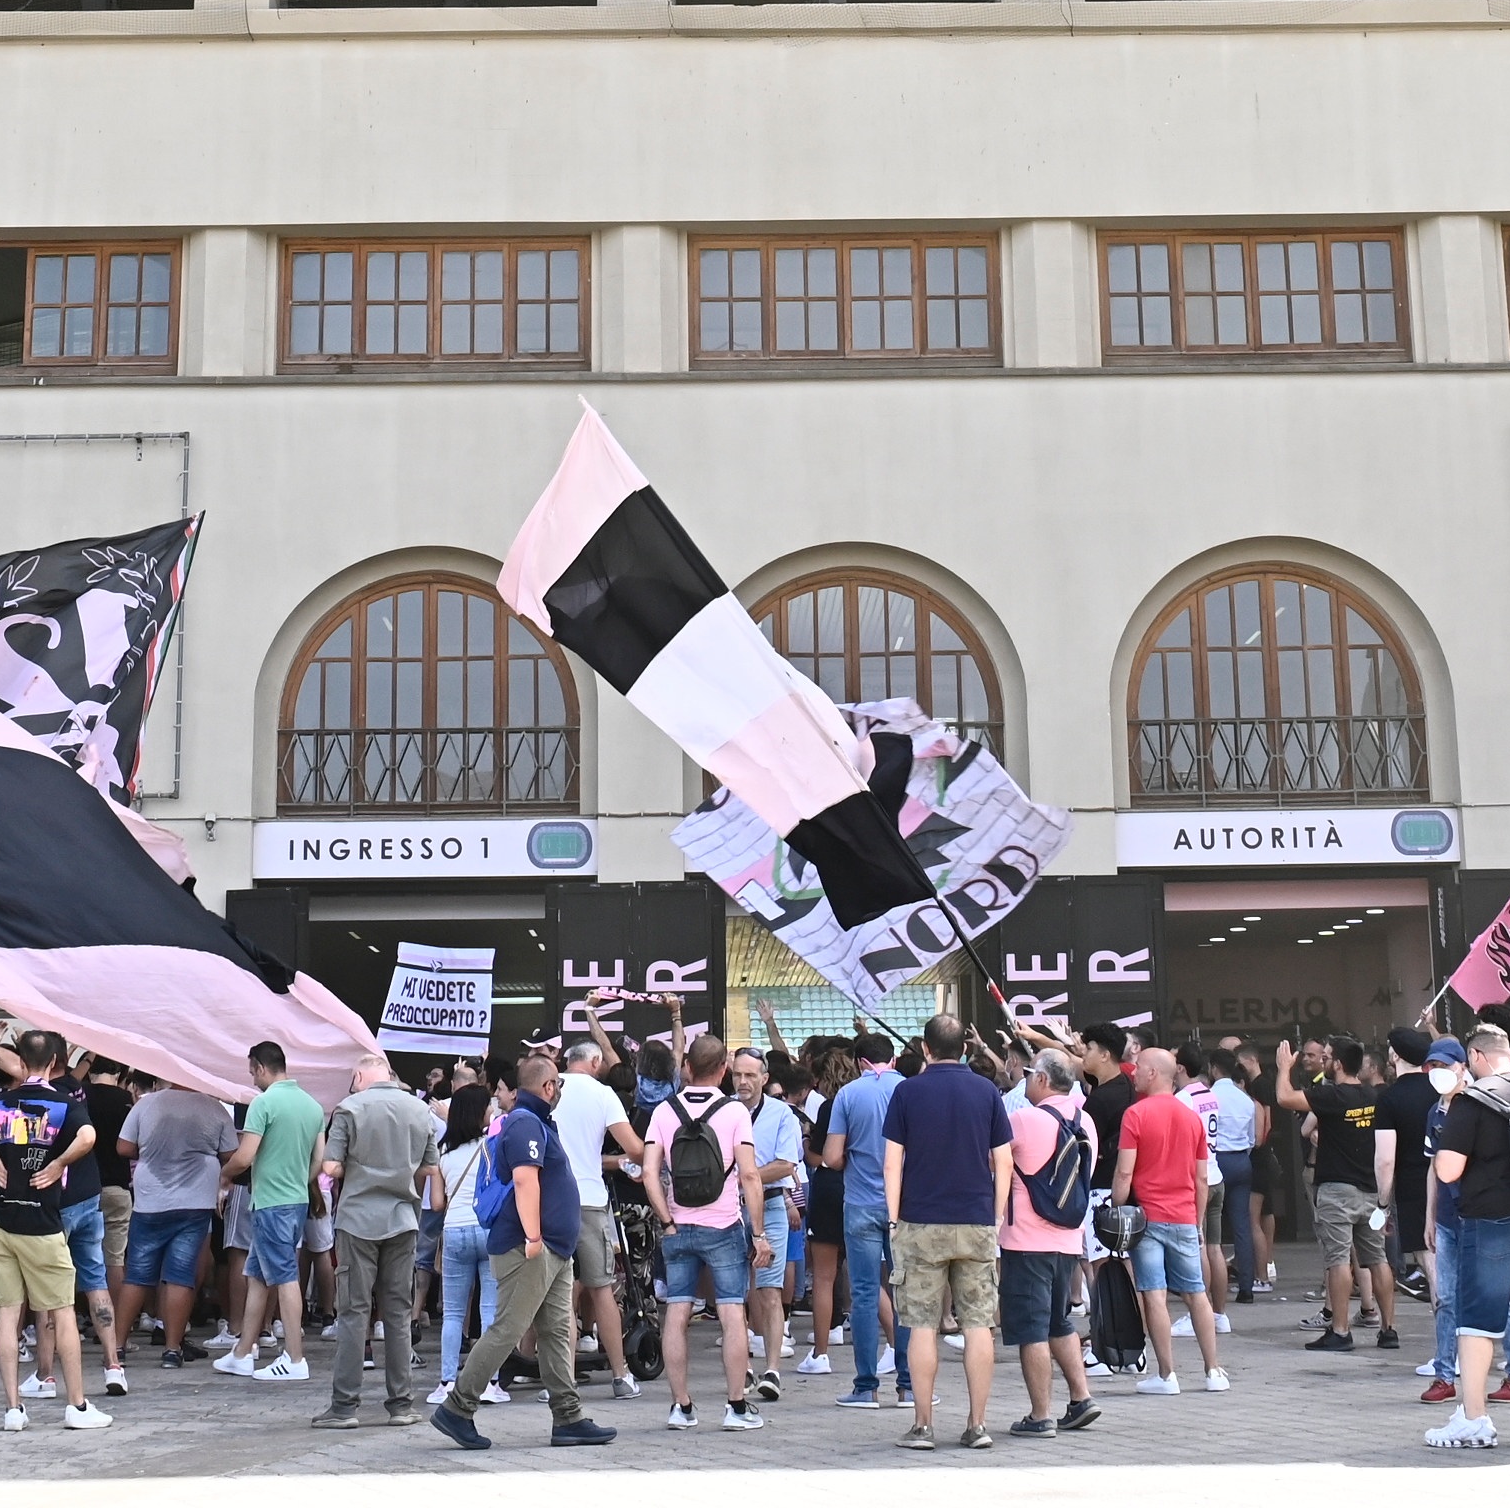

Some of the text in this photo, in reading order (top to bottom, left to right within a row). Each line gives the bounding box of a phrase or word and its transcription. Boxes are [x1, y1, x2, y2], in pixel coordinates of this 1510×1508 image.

[1173, 819, 1344, 850] AUTORITÀ
[289, 837, 489, 861] INGRESSO 1
[859, 844, 1040, 994] NORD
[400, 976, 477, 1003] MI VEDETE
[385, 1002, 475, 1028] PREOCCUPATO
[528, 1140, 539, 1160] 3
